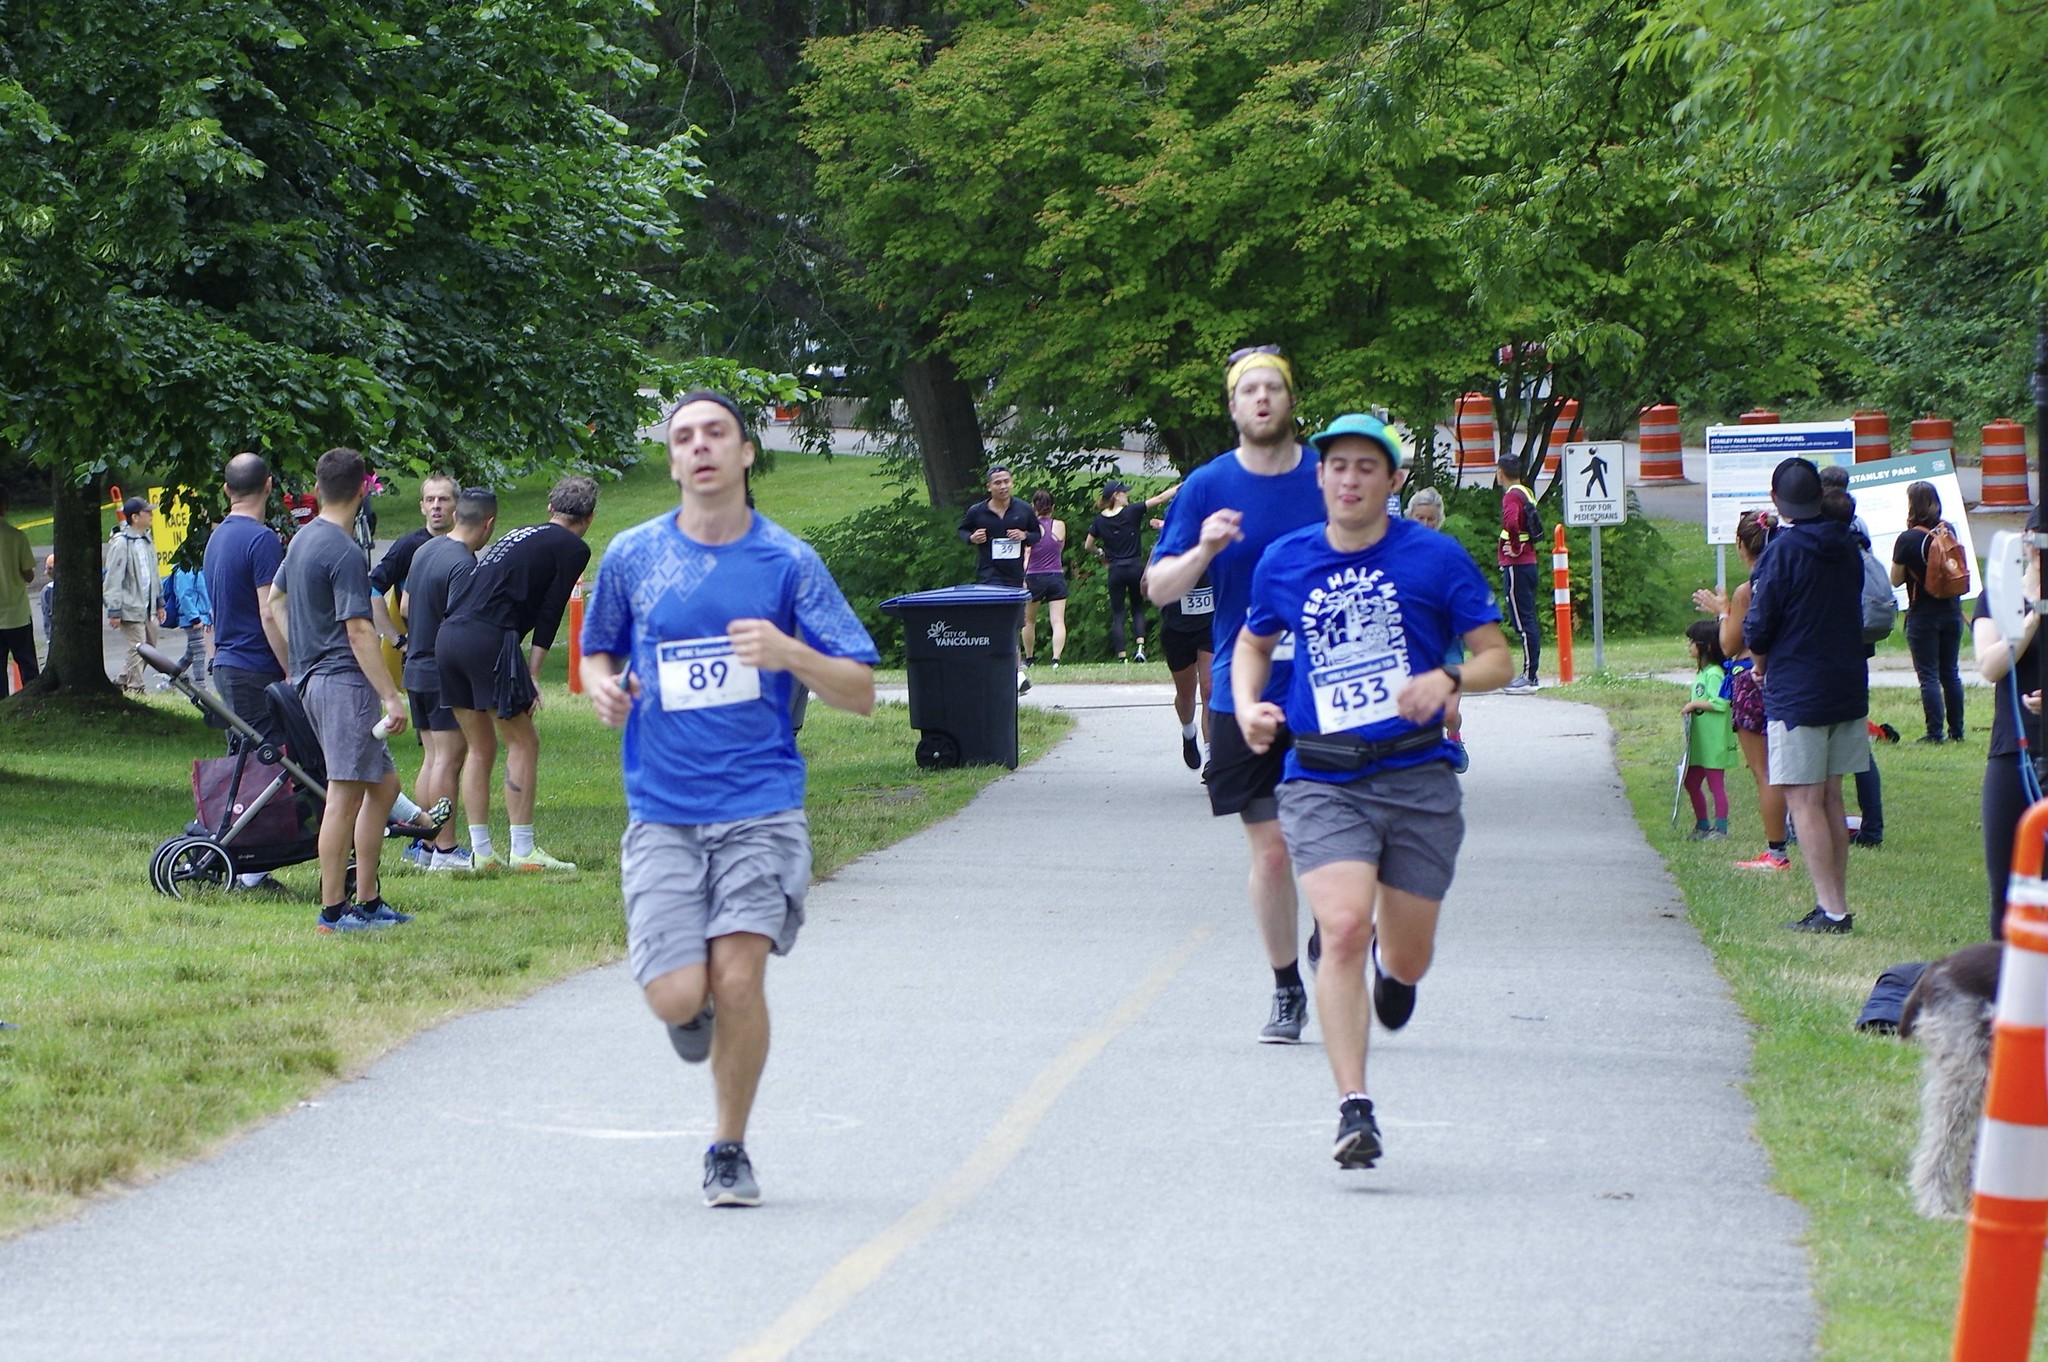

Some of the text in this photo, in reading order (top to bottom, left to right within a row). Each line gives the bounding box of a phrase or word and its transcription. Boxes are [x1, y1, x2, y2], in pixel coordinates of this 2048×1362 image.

[1849, 466, 1917, 484] STANLEY PARK
[1574, 513, 1618, 521] PEDESTRIANS
[1327, 567, 1384, 590] HALF
[1187, 596, 1211, 609] 330
[935, 637, 990, 647] VANCOUVER
[689, 661, 728, 690] 89
[1332, 677, 1389, 711] 433
